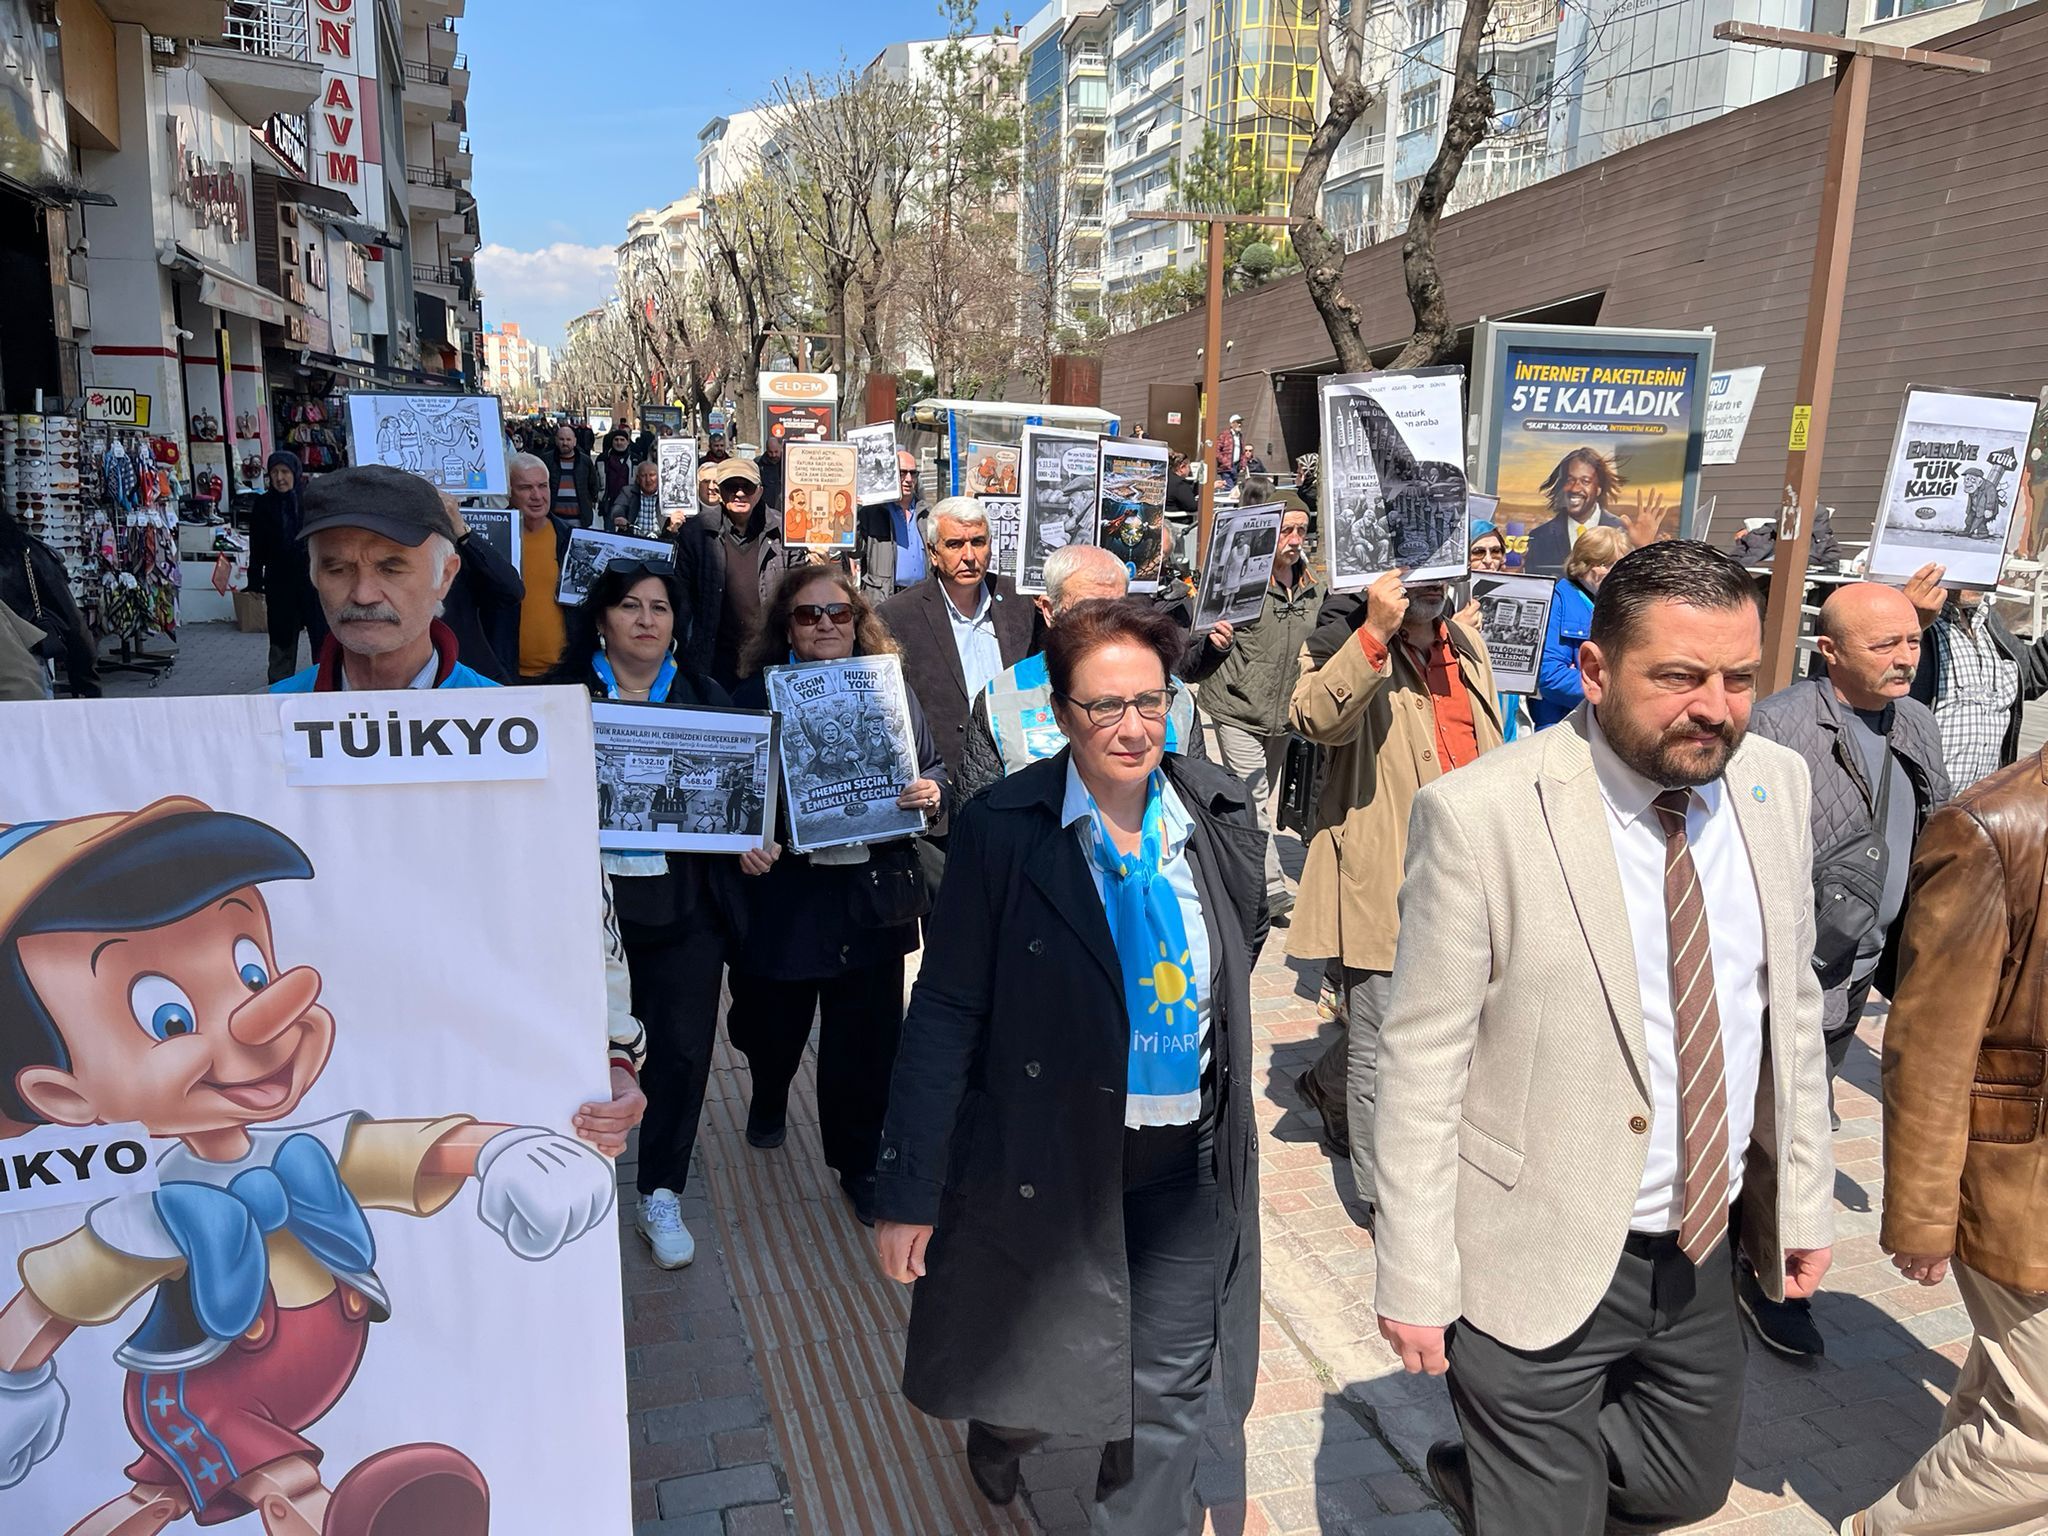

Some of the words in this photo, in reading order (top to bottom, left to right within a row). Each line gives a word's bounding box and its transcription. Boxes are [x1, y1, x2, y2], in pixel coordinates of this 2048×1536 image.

[324, 77, 359, 185] AVM
[1515, 360, 1589, 383] İNTERNET
[1592, 366, 1687, 387] PAKETLERİNİ
[775, 382, 822, 391] ELDEM
[1554, 388, 1685, 417] KATLADIK
[1414, 419, 1439, 428] araba
[1906, 439, 1980, 461] EMEKLİYE
[1991, 452, 2016, 468] TÜİK
[1913, 461, 1962, 480] TÜİK
[1904, 479, 1958, 498] KAZIĞI
[1505, 535, 1530, 554] 5G
[793, 675, 826, 692] GEÇİM
[844, 670, 878, 681] HUZUR
[847, 679, 875, 689] YOK!
[799, 685, 826, 700] YOK!
[294, 710, 539, 759] TÜİKYO
[611, 727, 650, 739] RAKAMLARI
[637, 758, 665, 766] %32.10
[684, 777, 713, 786] %68.50
[811, 784, 852, 799] #HEMEN
[853, 775, 888, 789] SEÇİM
[806, 793, 858, 813] EMEKLİYE
[859, 786, 902, 801] GEÇİM!
[1134, 1030, 1158, 1053] İYİ
